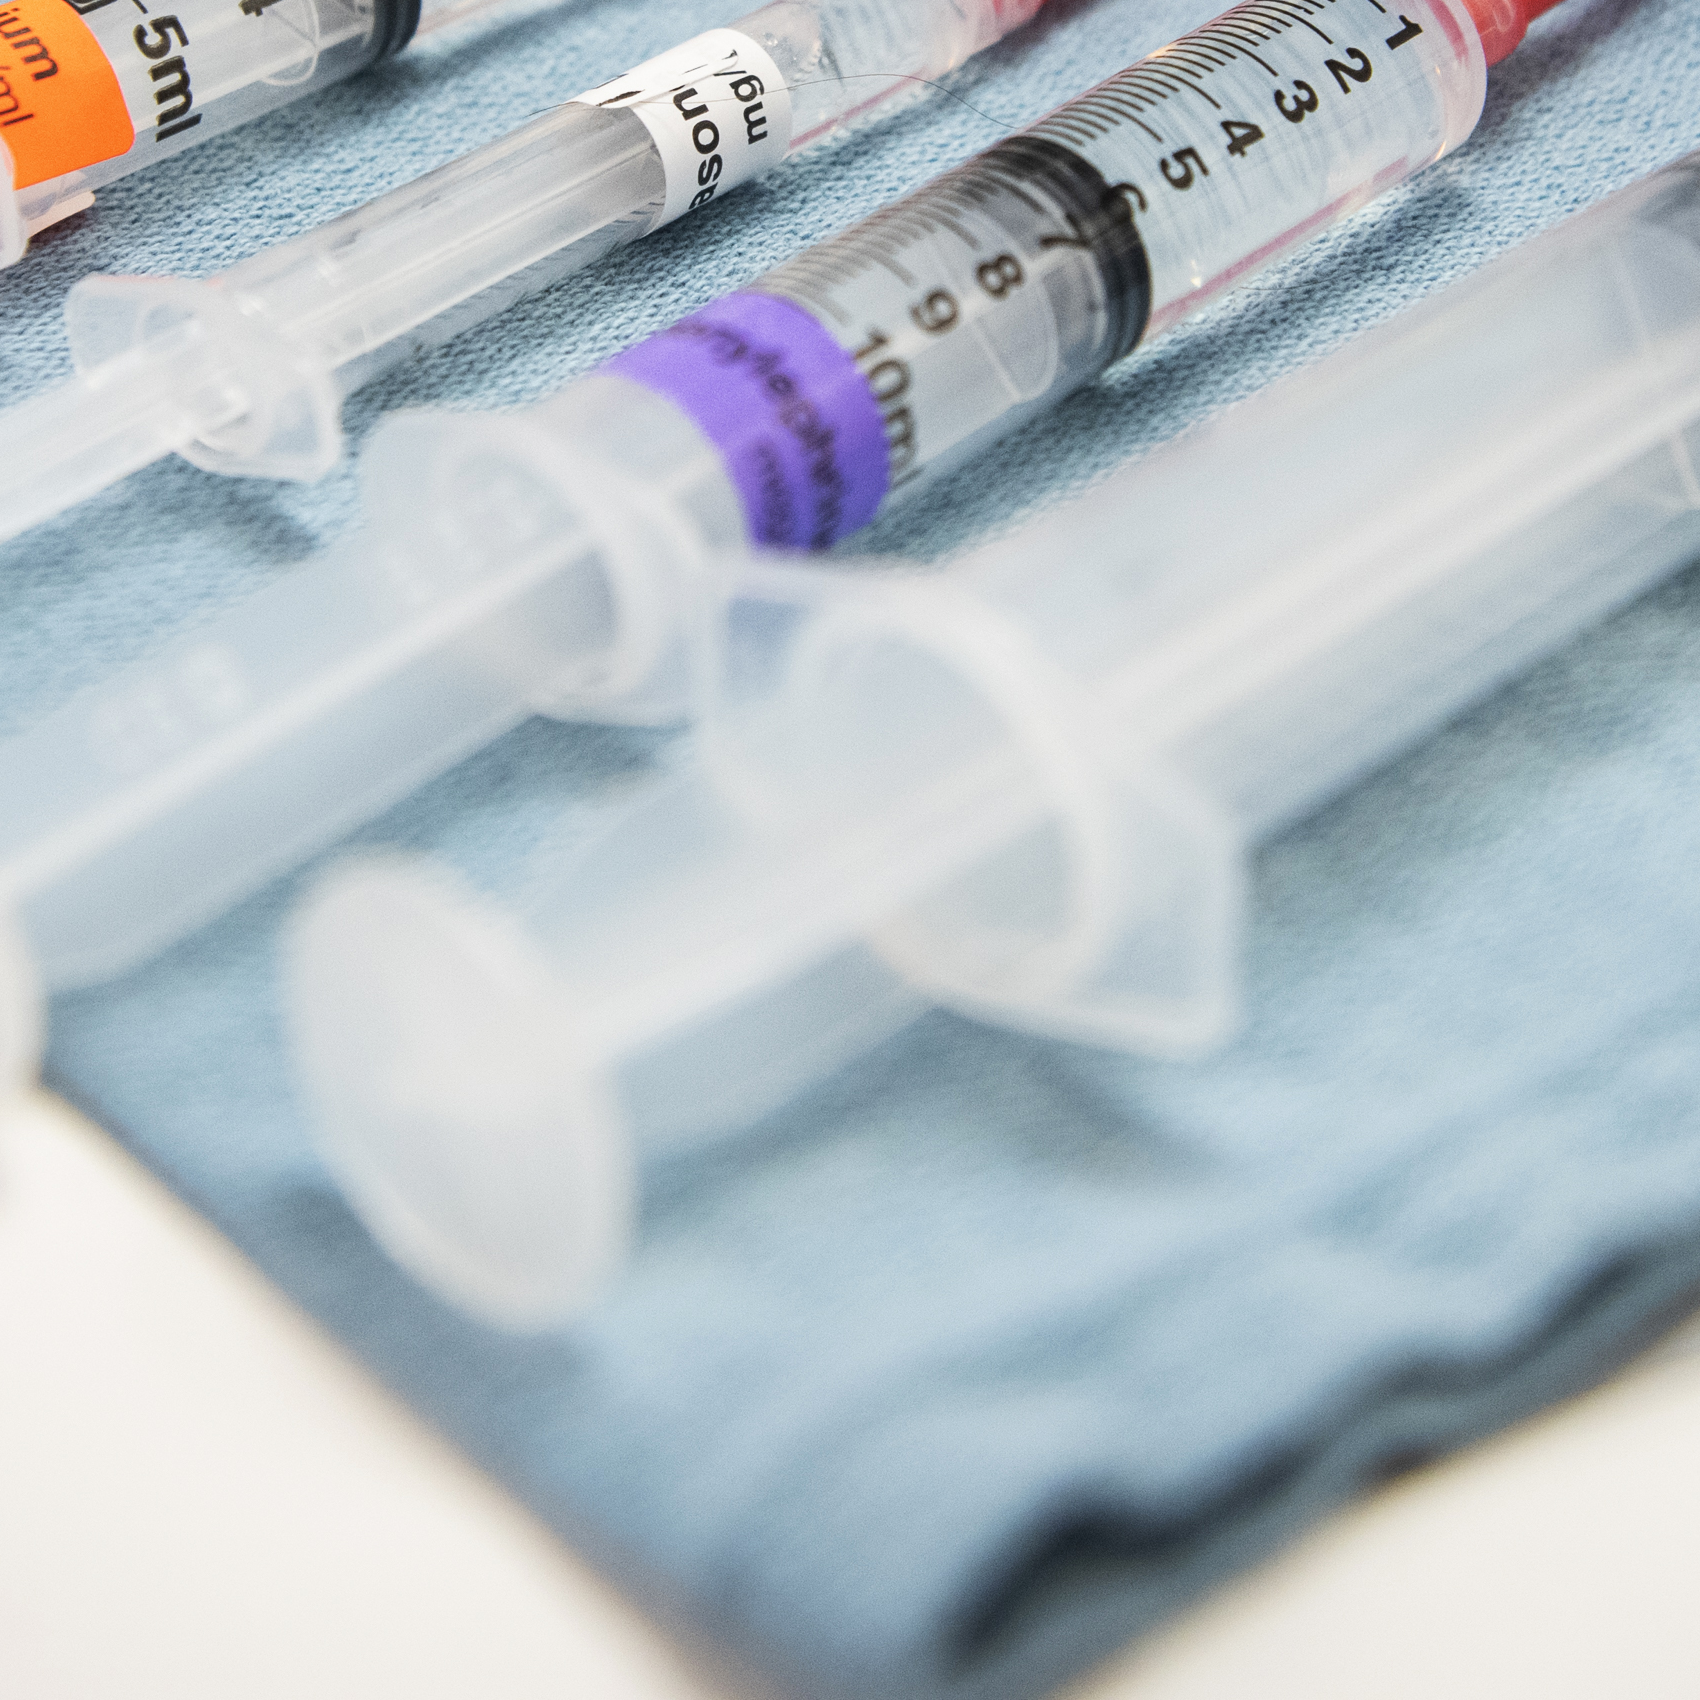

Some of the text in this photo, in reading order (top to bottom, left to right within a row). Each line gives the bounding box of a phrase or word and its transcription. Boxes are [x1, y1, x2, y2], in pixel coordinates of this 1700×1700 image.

[1384, 13, 1425, 51] 1
[131, 13, 204, 143] 5ml
[1323, 46, 1374, 95] 2
[712, 69, 769, 146] mg/
[1273, 78, 1320, 124] 3
[671, 84, 724, 211] ason
[1219, 119, 1266, 158] 4
[1159, 146, 1210, 192] 5
[1099, 181, 1148, 228] 6
[1038, 212, 1093, 249] 7
[974, 252, 1025, 301] 8
[908, 287, 961, 337] 9
[854, 322, 925, 493] 10ml
